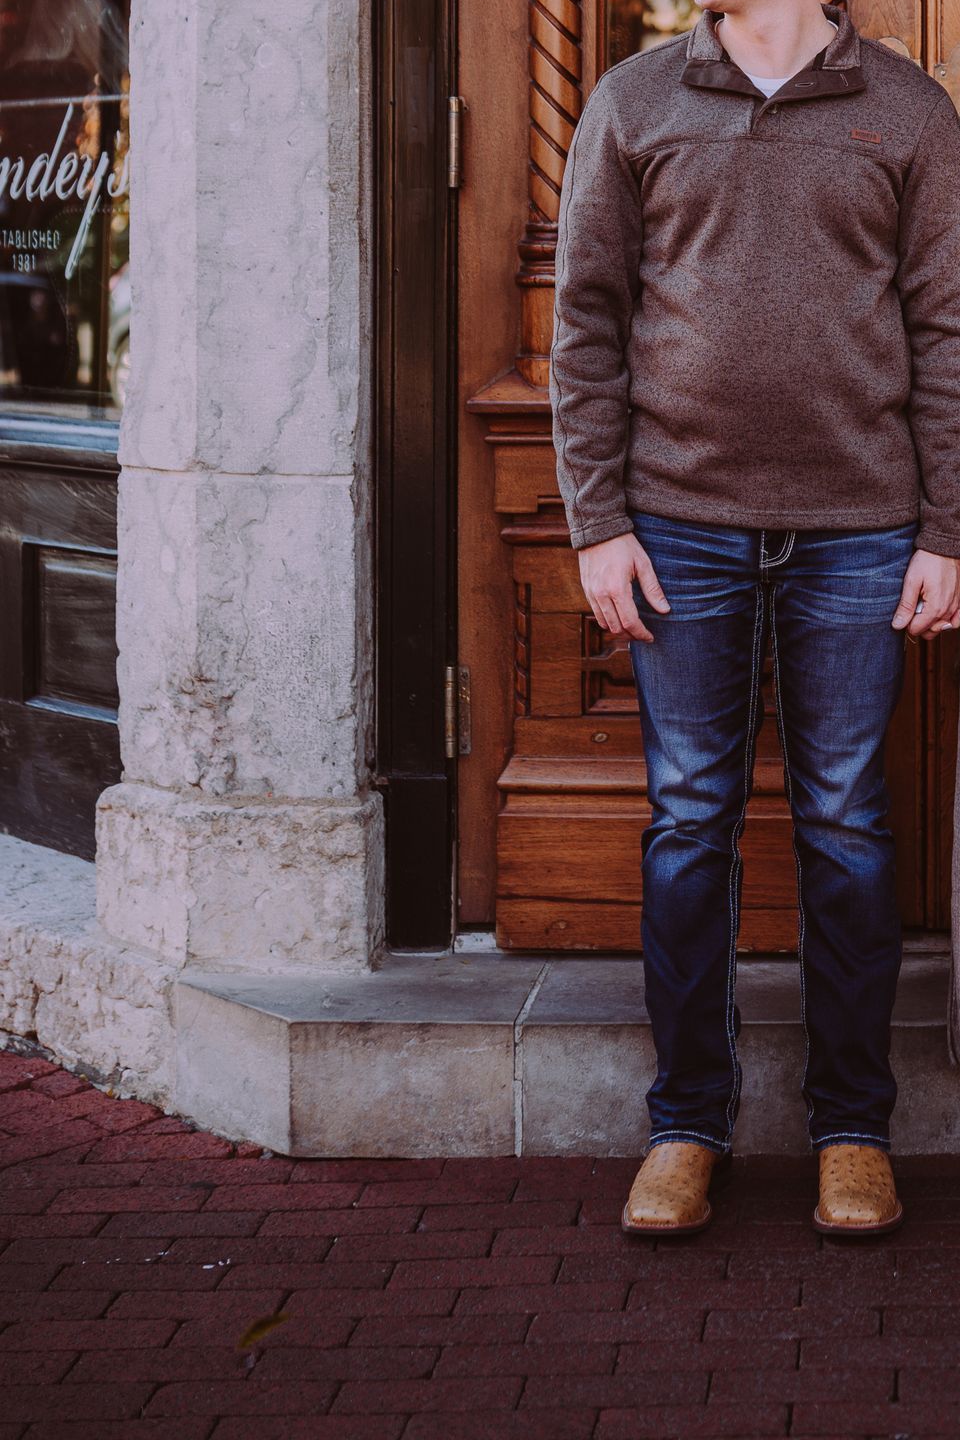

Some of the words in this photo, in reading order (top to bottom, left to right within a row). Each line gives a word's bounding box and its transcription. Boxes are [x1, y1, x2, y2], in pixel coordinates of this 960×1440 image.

[0, 102, 130, 280] ndey's
[0, 229, 60, 251] TABLISHED
[12, 253, 36, 272] 1981
